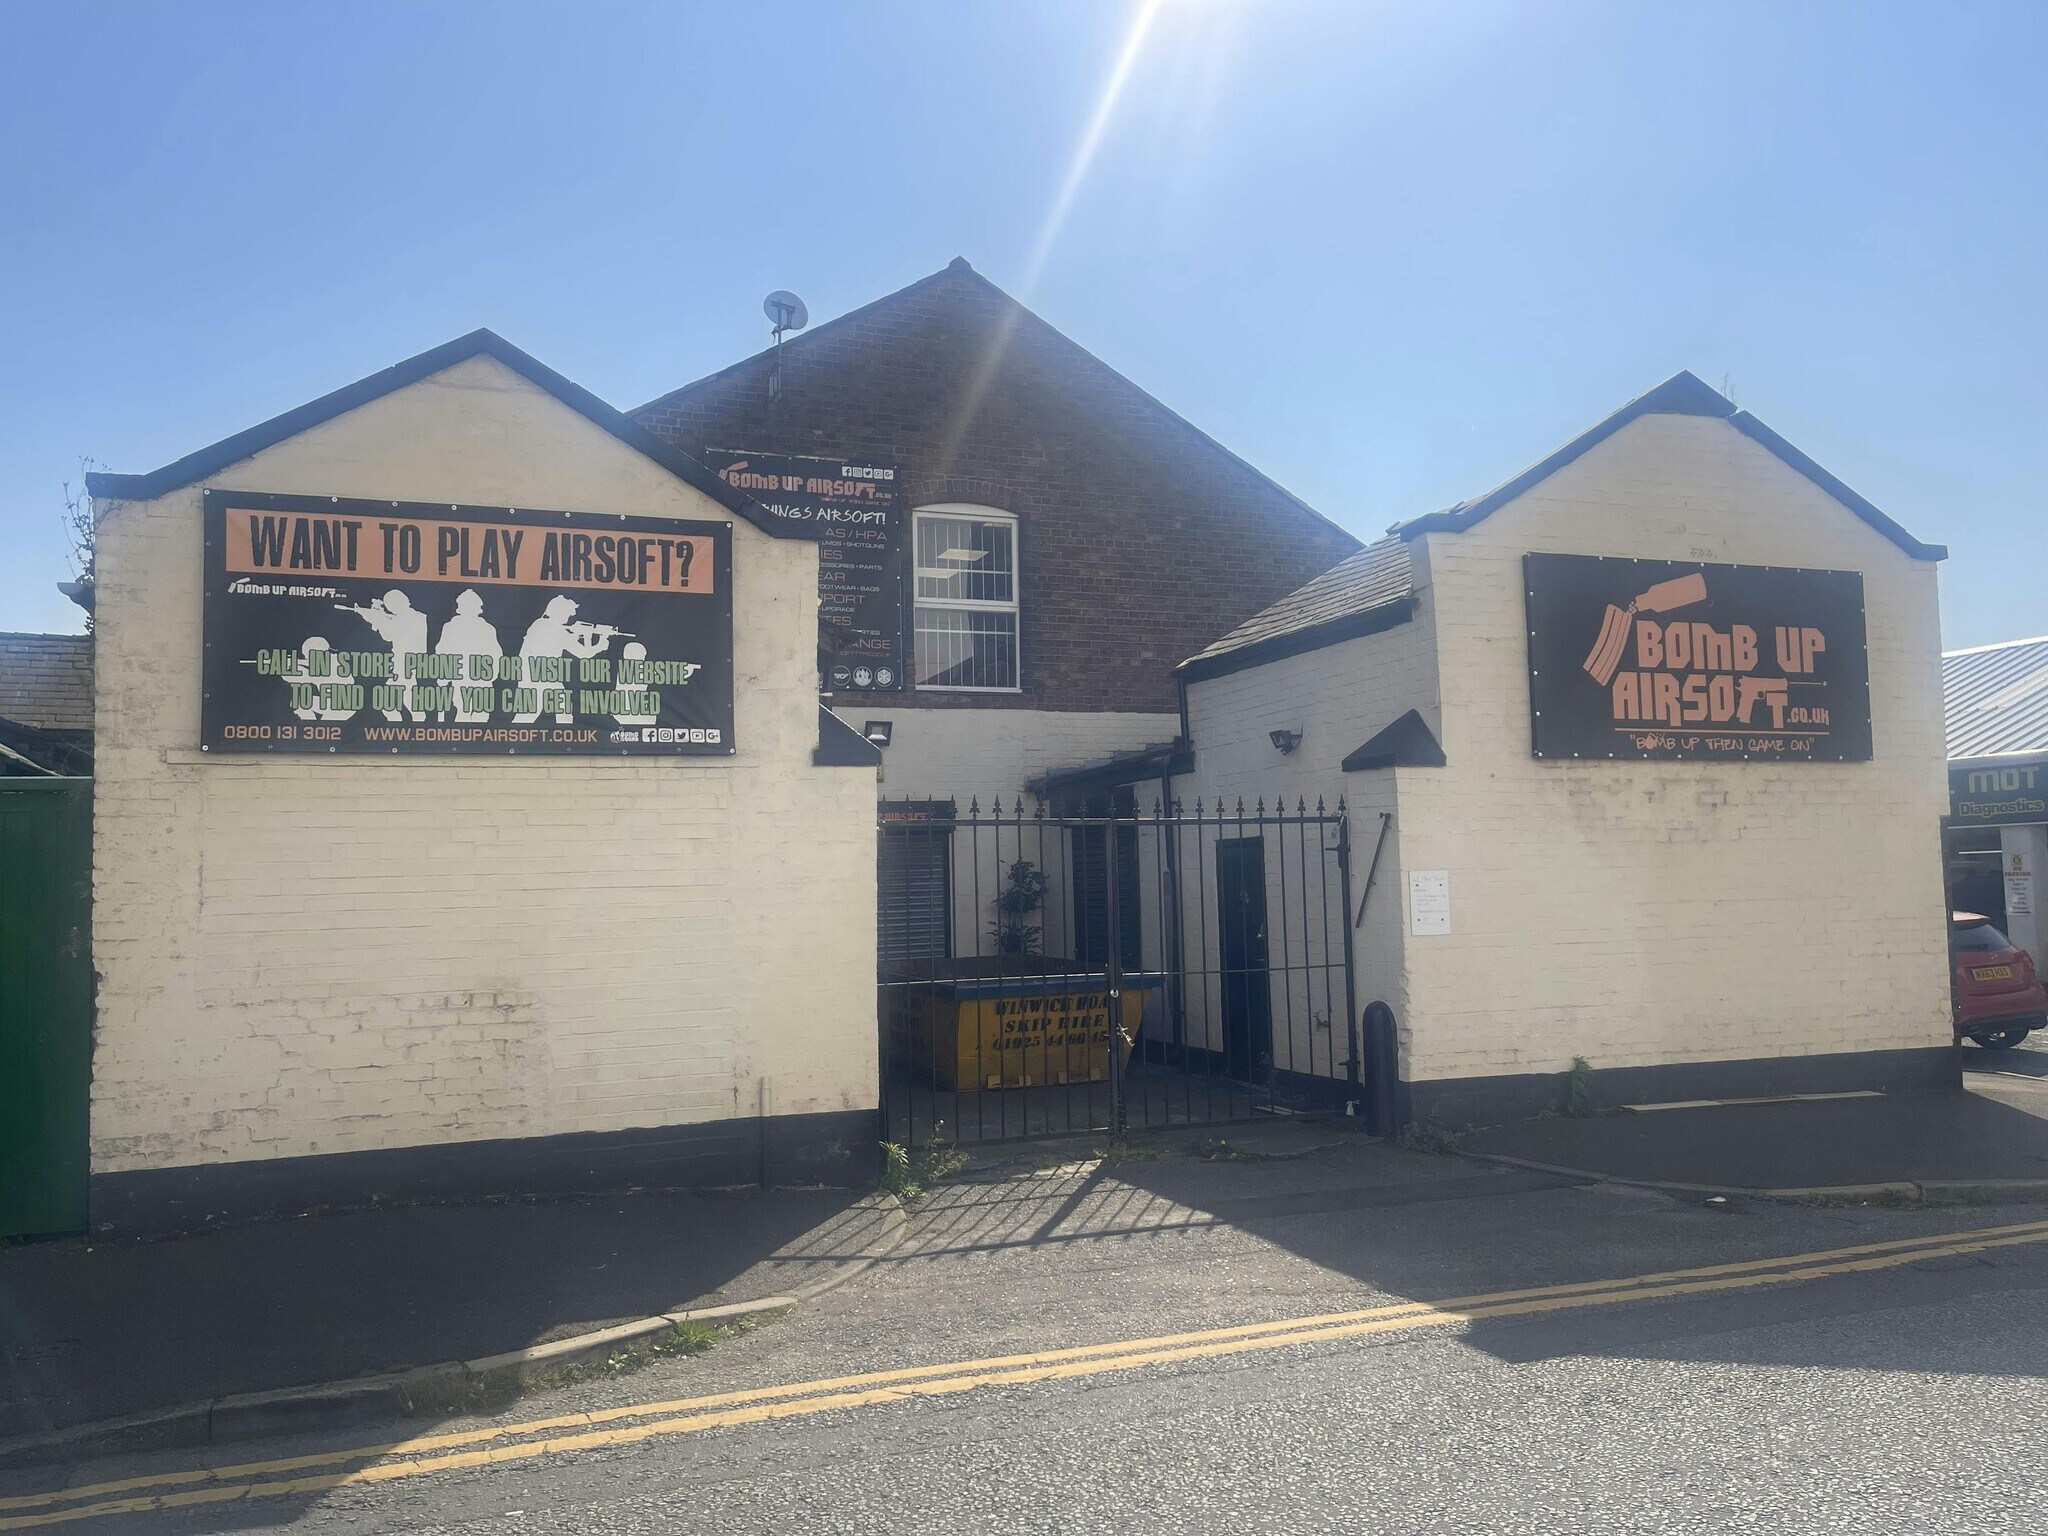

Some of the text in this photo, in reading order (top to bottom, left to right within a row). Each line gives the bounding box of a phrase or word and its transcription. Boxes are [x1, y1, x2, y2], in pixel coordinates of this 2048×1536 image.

[728, 471, 780, 490] BOMB
[782, 475, 804, 492] UP
[807, 478, 875, 499] AIRSOFT
[816, 508, 886, 525] AIRSOFT!
[856, 530, 888, 541] HPA
[250, 515, 694, 587] WANT TO PLAY AIRSOFT?
[237, 583, 270, 595] BOMB
[272, 585, 287, 595] UP
[288, 586, 336, 598] AIRSOFT
[1636, 620, 1826, 673] BOMB UP
[257, 649, 689, 685] CALL IN STORE, PHONE US OR VISIT OUR WEBSITE
[290, 682, 661, 715] TO FIND OUT HOW YOU CAN GET INVOLVED
[224, 726, 598, 742] 0800 131 3012 WWW.BOMBUPAIRSOFT.CO.UK
[1681, 737, 1700, 749] UP
[1706, 738, 1743, 750] THEN
[1748, 739, 1785, 751] GAME
[1968, 767, 2040, 793] MOT
[1959, 798, 2044, 818] Diagnostics
[995, 996, 1109, 1016] WINWICK ROA
[1004, 1014, 1104, 1033] SKIP HIRE
